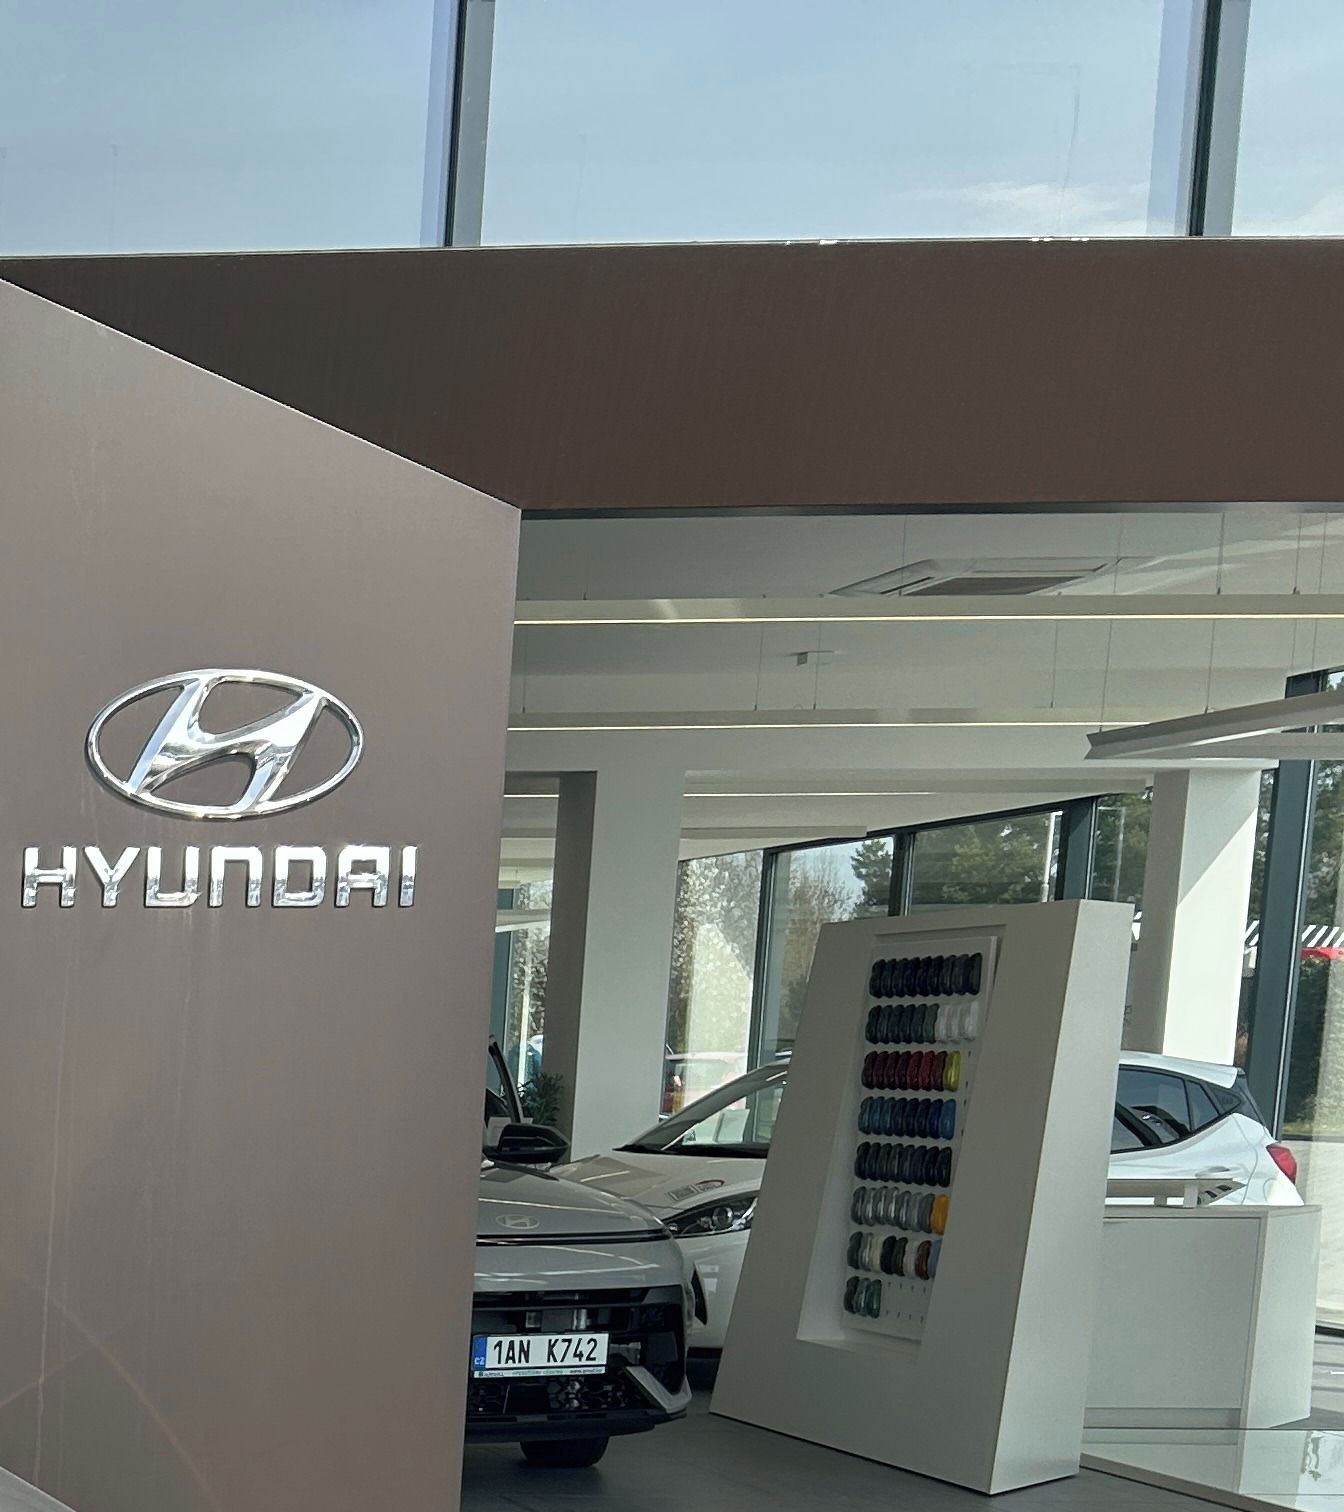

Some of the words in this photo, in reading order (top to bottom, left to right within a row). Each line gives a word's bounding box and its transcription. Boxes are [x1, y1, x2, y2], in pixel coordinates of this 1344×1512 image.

[20, 844, 420, 910] HYUNDAI
[493, 1338, 531, 1365] 1AN
[546, 1337, 599, 1364] K742
